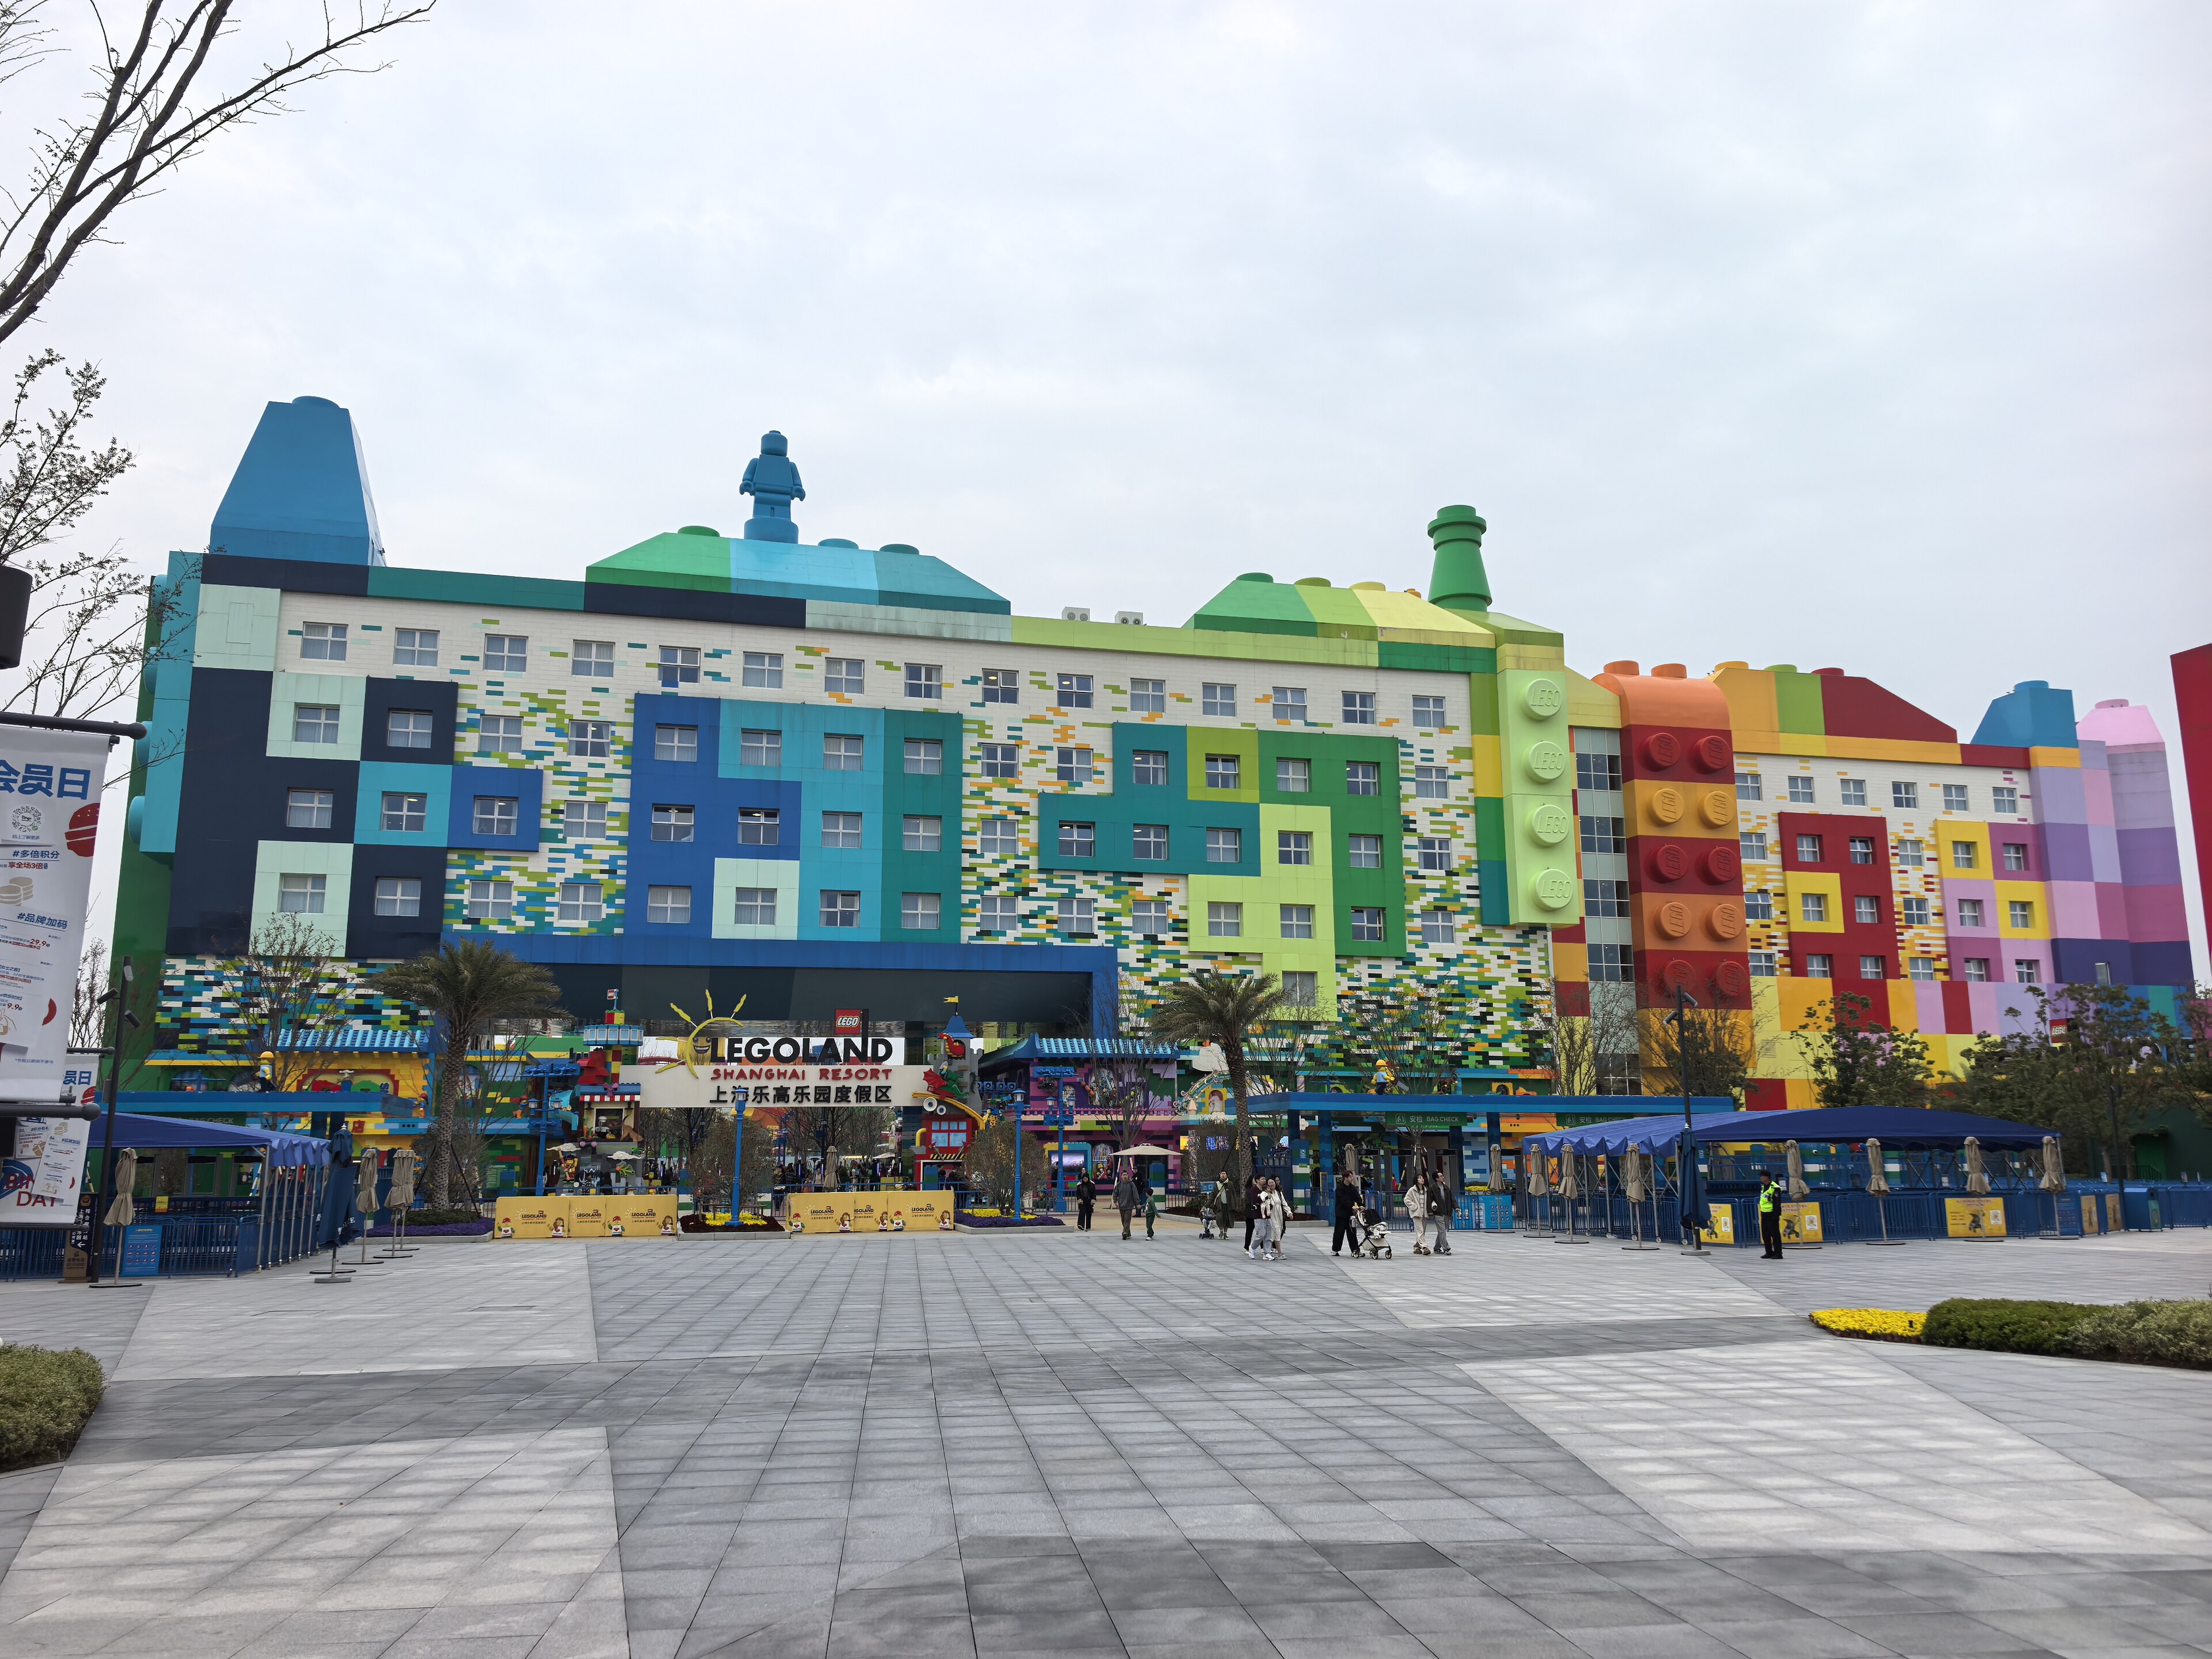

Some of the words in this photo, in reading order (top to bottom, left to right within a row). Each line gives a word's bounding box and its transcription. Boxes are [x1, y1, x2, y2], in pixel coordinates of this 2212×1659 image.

[1531, 688, 1560, 707] LEGO
[1658, 735, 1673, 764] LEGO
[1709, 738, 1724, 767] LEGO
[1533, 751, 1564, 770] LEGO
[0, 760, 90, 800] 会员日
[1661, 791, 1677, 820] LEGO
[1713, 794, 1728, 823] LEGO
[1537, 815, 1567, 833] LEGO
[13, 850, 60, 859] #多倍积分
[1665, 848, 1682, 877] LEGO
[1717, 850, 1732, 878] LEGO
[1541, 880, 1571, 898] LEGO
[17, 912, 68, 929] #品牌加码
[1669, 905, 1685, 934] LEGO
[1721, 907, 1736, 935] LEGO
[7, 1002, 20, 1010] 9.9
[836, 1016, 859, 1027] LEGO
[710, 1037, 893, 1064] LEGOLAND
[63, 1070, 92, 1085] 员日
[711, 1067, 805, 1080] SHANGHAI
[819, 1068, 892, 1081] RESORT
[351, 1120, 365, 1133] 店
